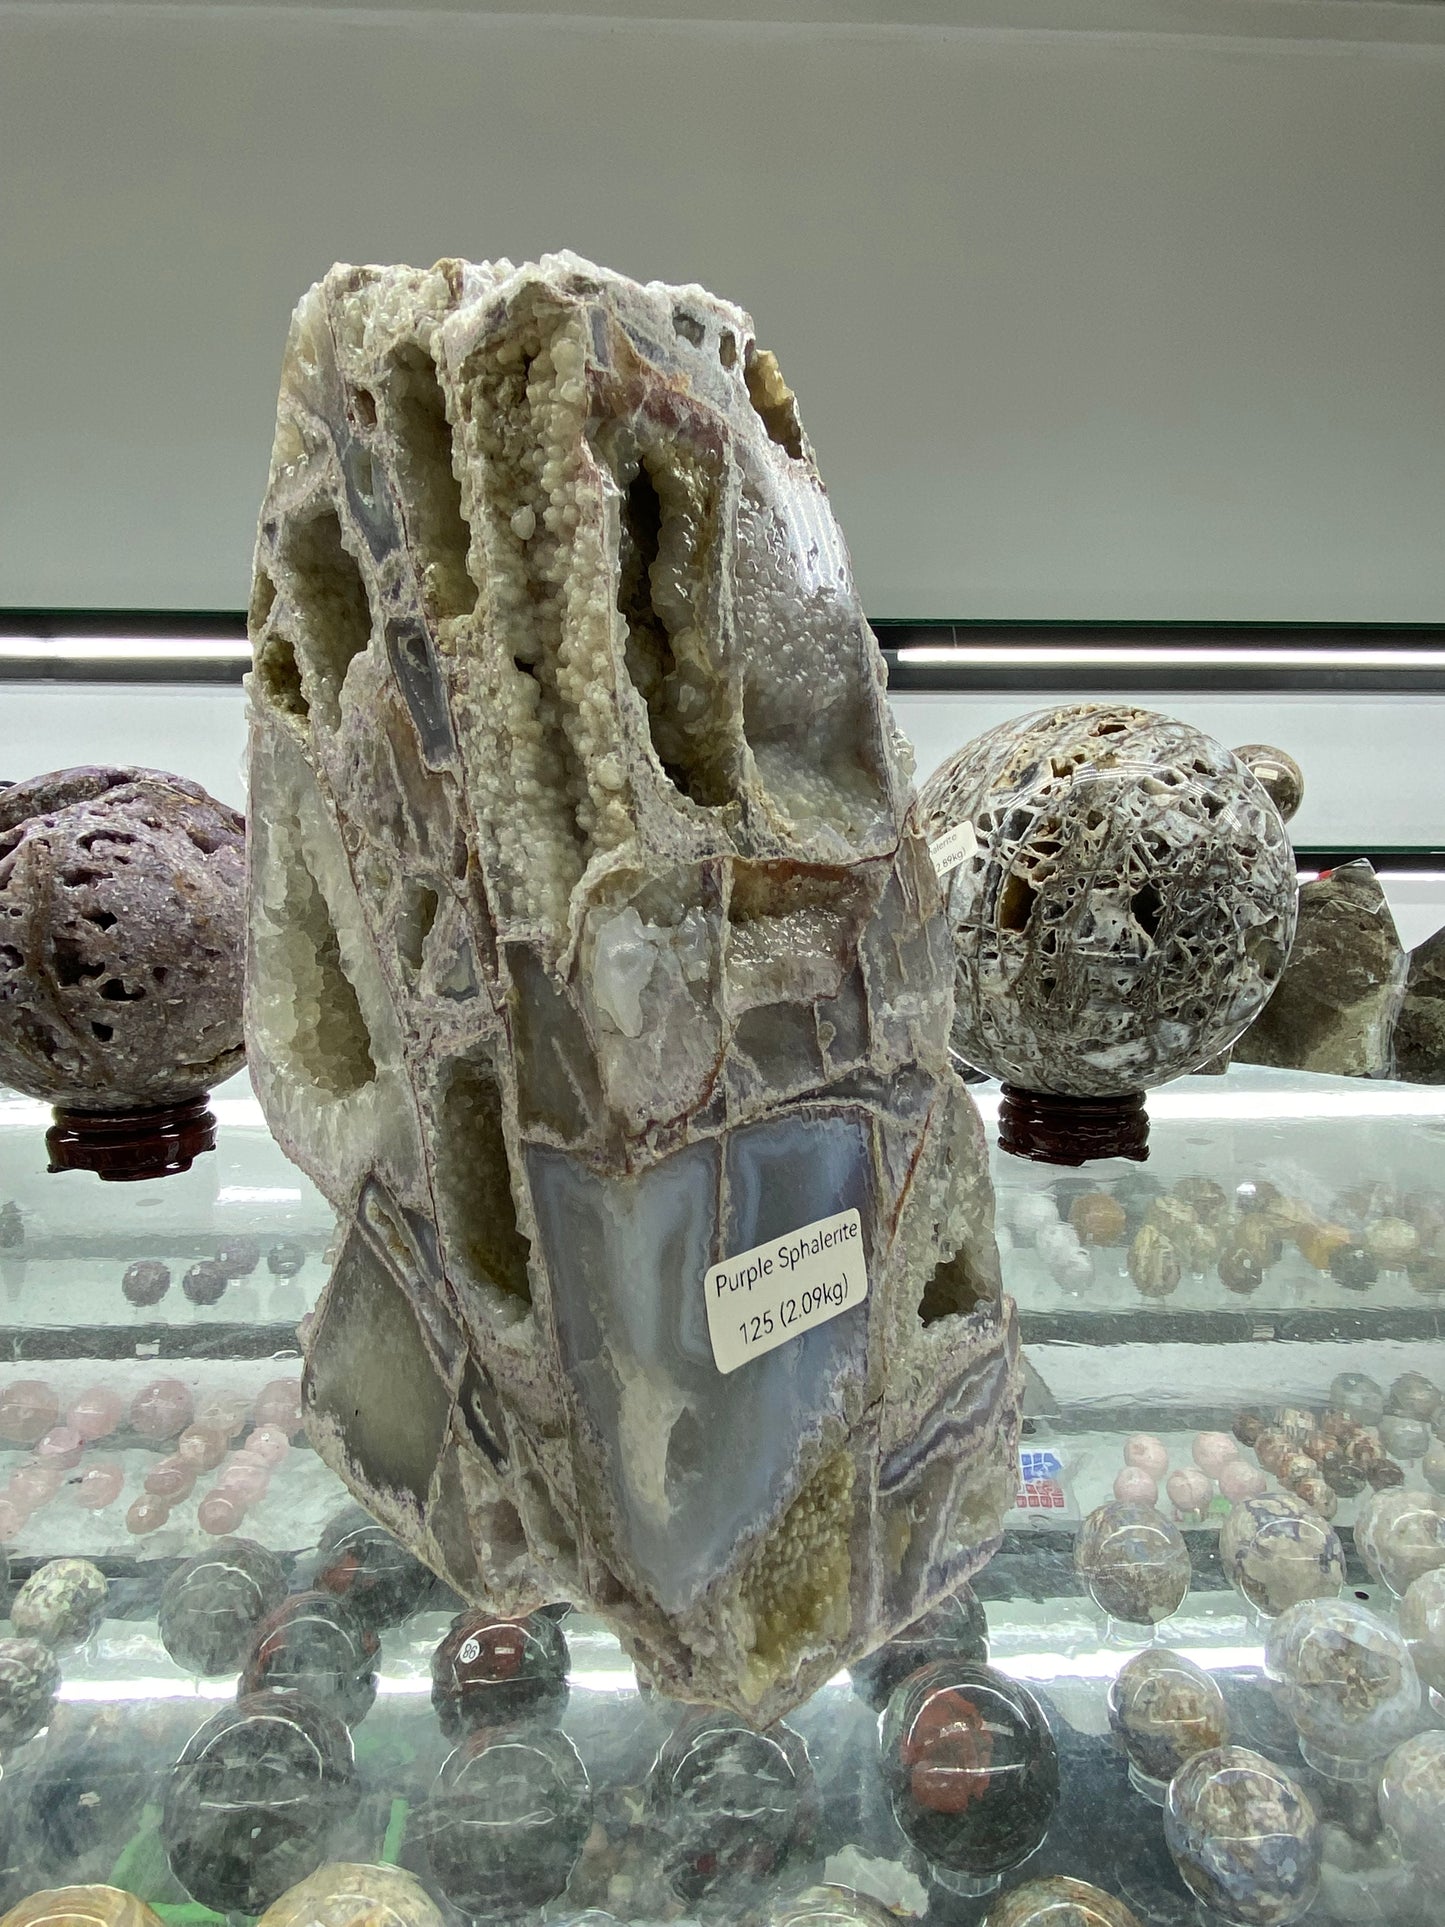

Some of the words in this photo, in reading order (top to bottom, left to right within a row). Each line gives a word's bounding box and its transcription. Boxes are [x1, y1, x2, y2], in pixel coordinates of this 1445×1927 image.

[716, 1257, 774, 1297] Purple
[778, 1223, 858, 1271] Sphalerite
[739, 1310, 774, 1345] 125
[780, 1272, 849, 1328] (2.09kg)
[463, 1644, 478, 1659] 86
